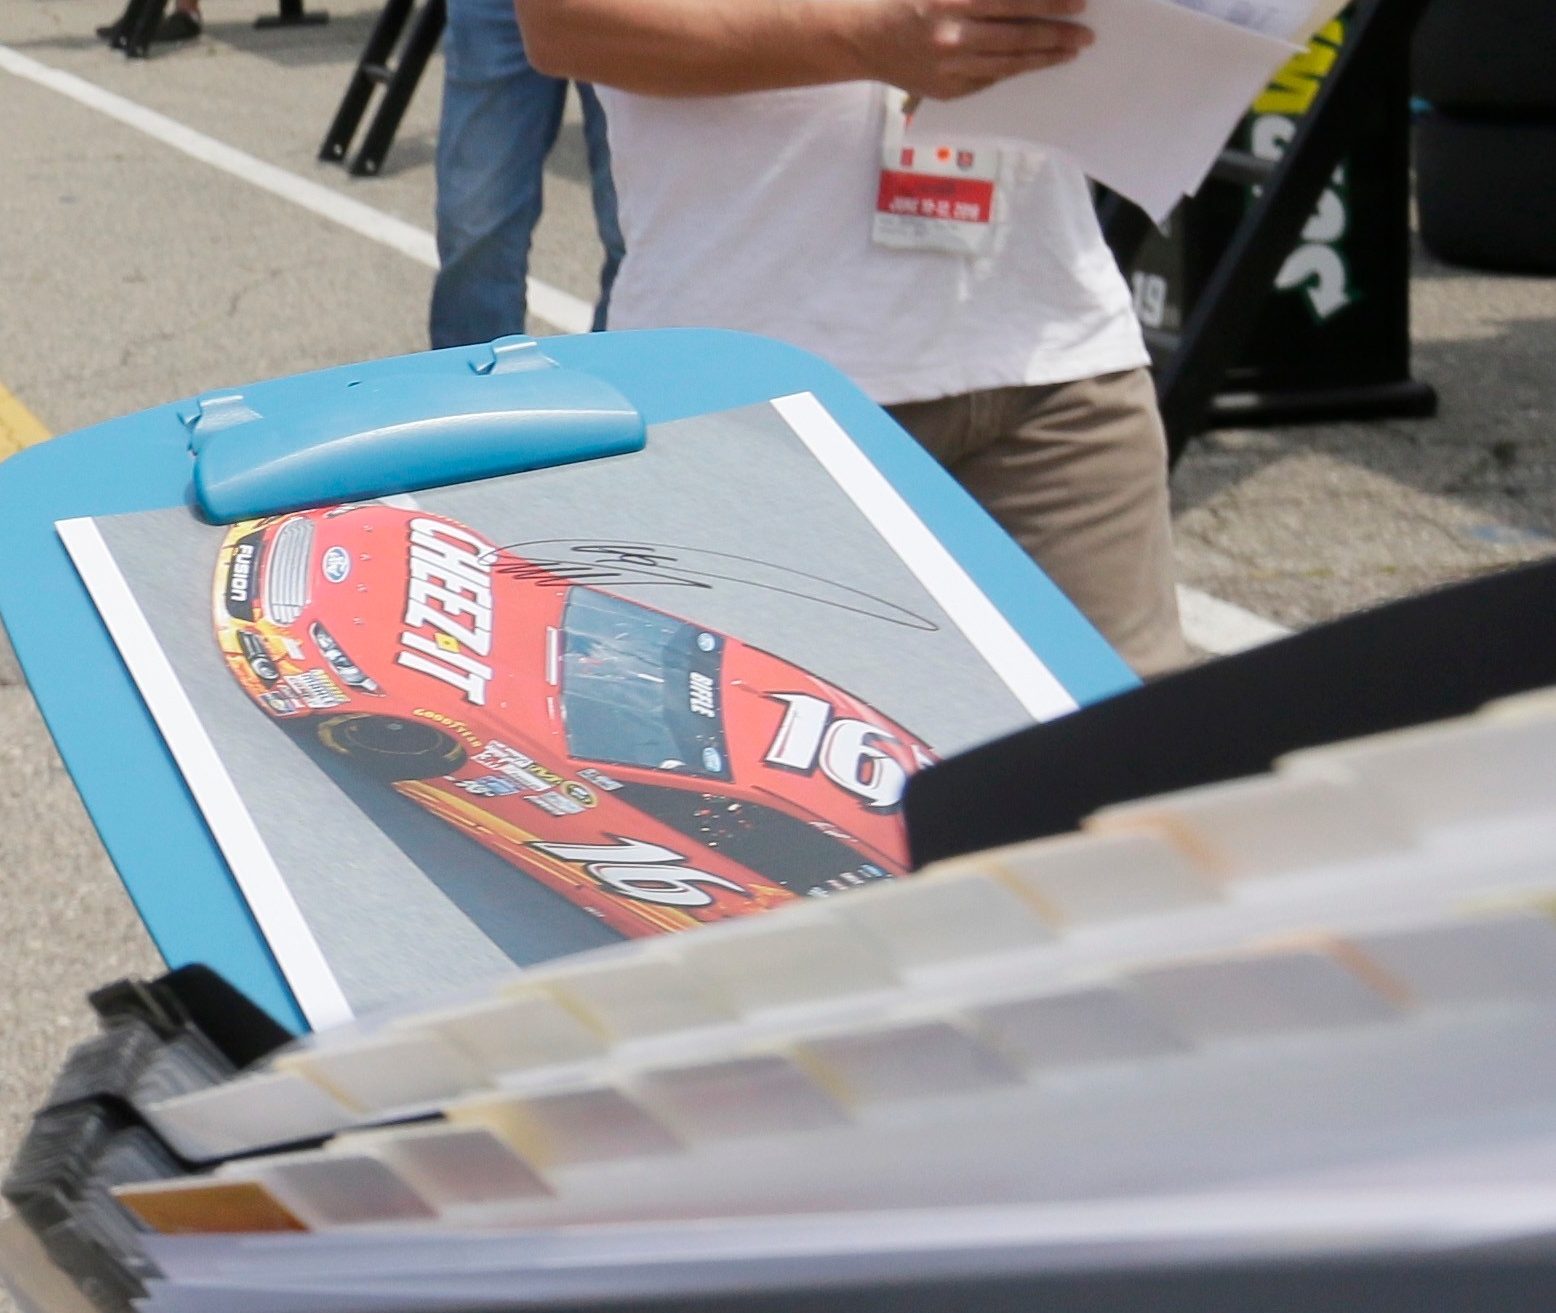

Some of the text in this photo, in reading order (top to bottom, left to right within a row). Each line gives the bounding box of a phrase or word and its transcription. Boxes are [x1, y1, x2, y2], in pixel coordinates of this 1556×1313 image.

[230, 544, 255, 602] FUSION
[763, 692, 907, 808] 16
[529, 836, 748, 907] 16
